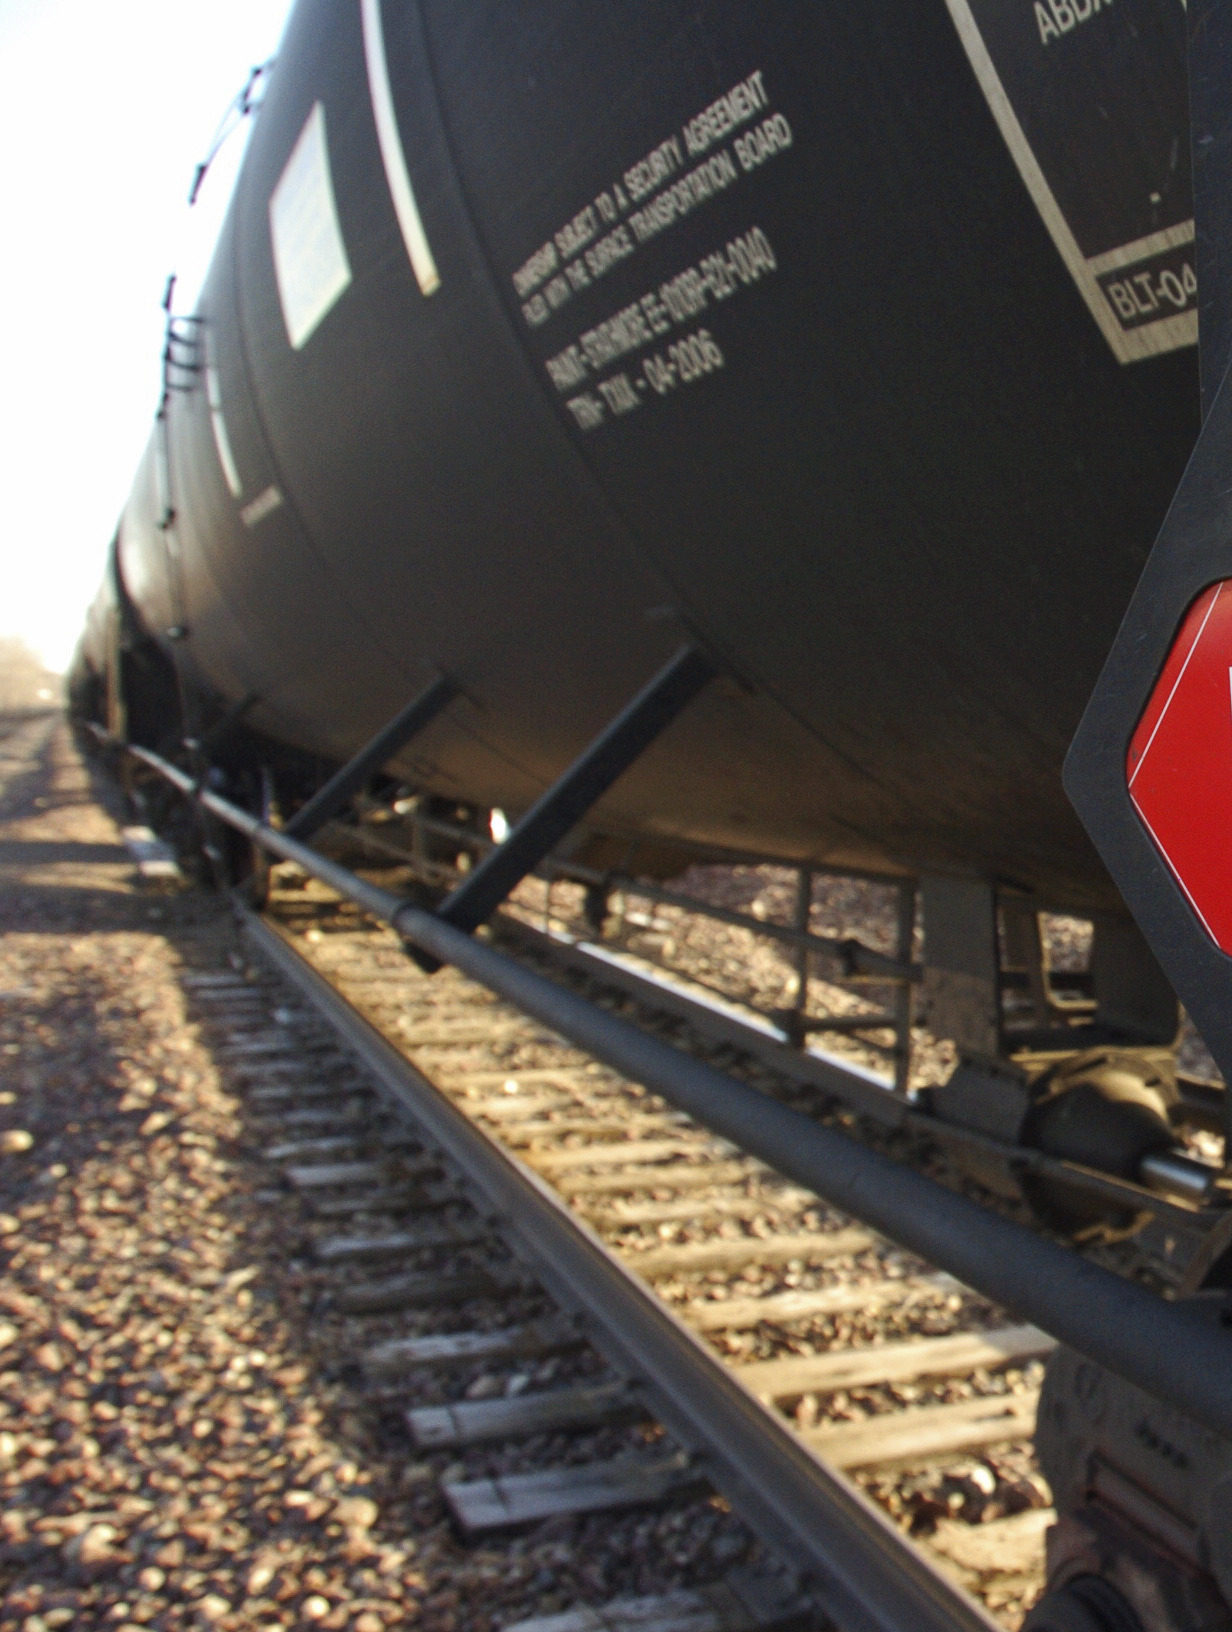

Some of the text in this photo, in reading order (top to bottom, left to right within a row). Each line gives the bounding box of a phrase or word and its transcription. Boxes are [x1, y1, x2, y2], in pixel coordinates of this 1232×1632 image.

[1034, 0, 1113, 45] ABD
[594, 192, 618, 223] TO
[613, 182, 629, 212] A
[623, 134, 684, 202] SECURITY
[682, 69, 769, 157] AGREEMENT
[628, 149, 738, 242] TRANSPORTATION
[733, 113, 793, 172] BOARD
